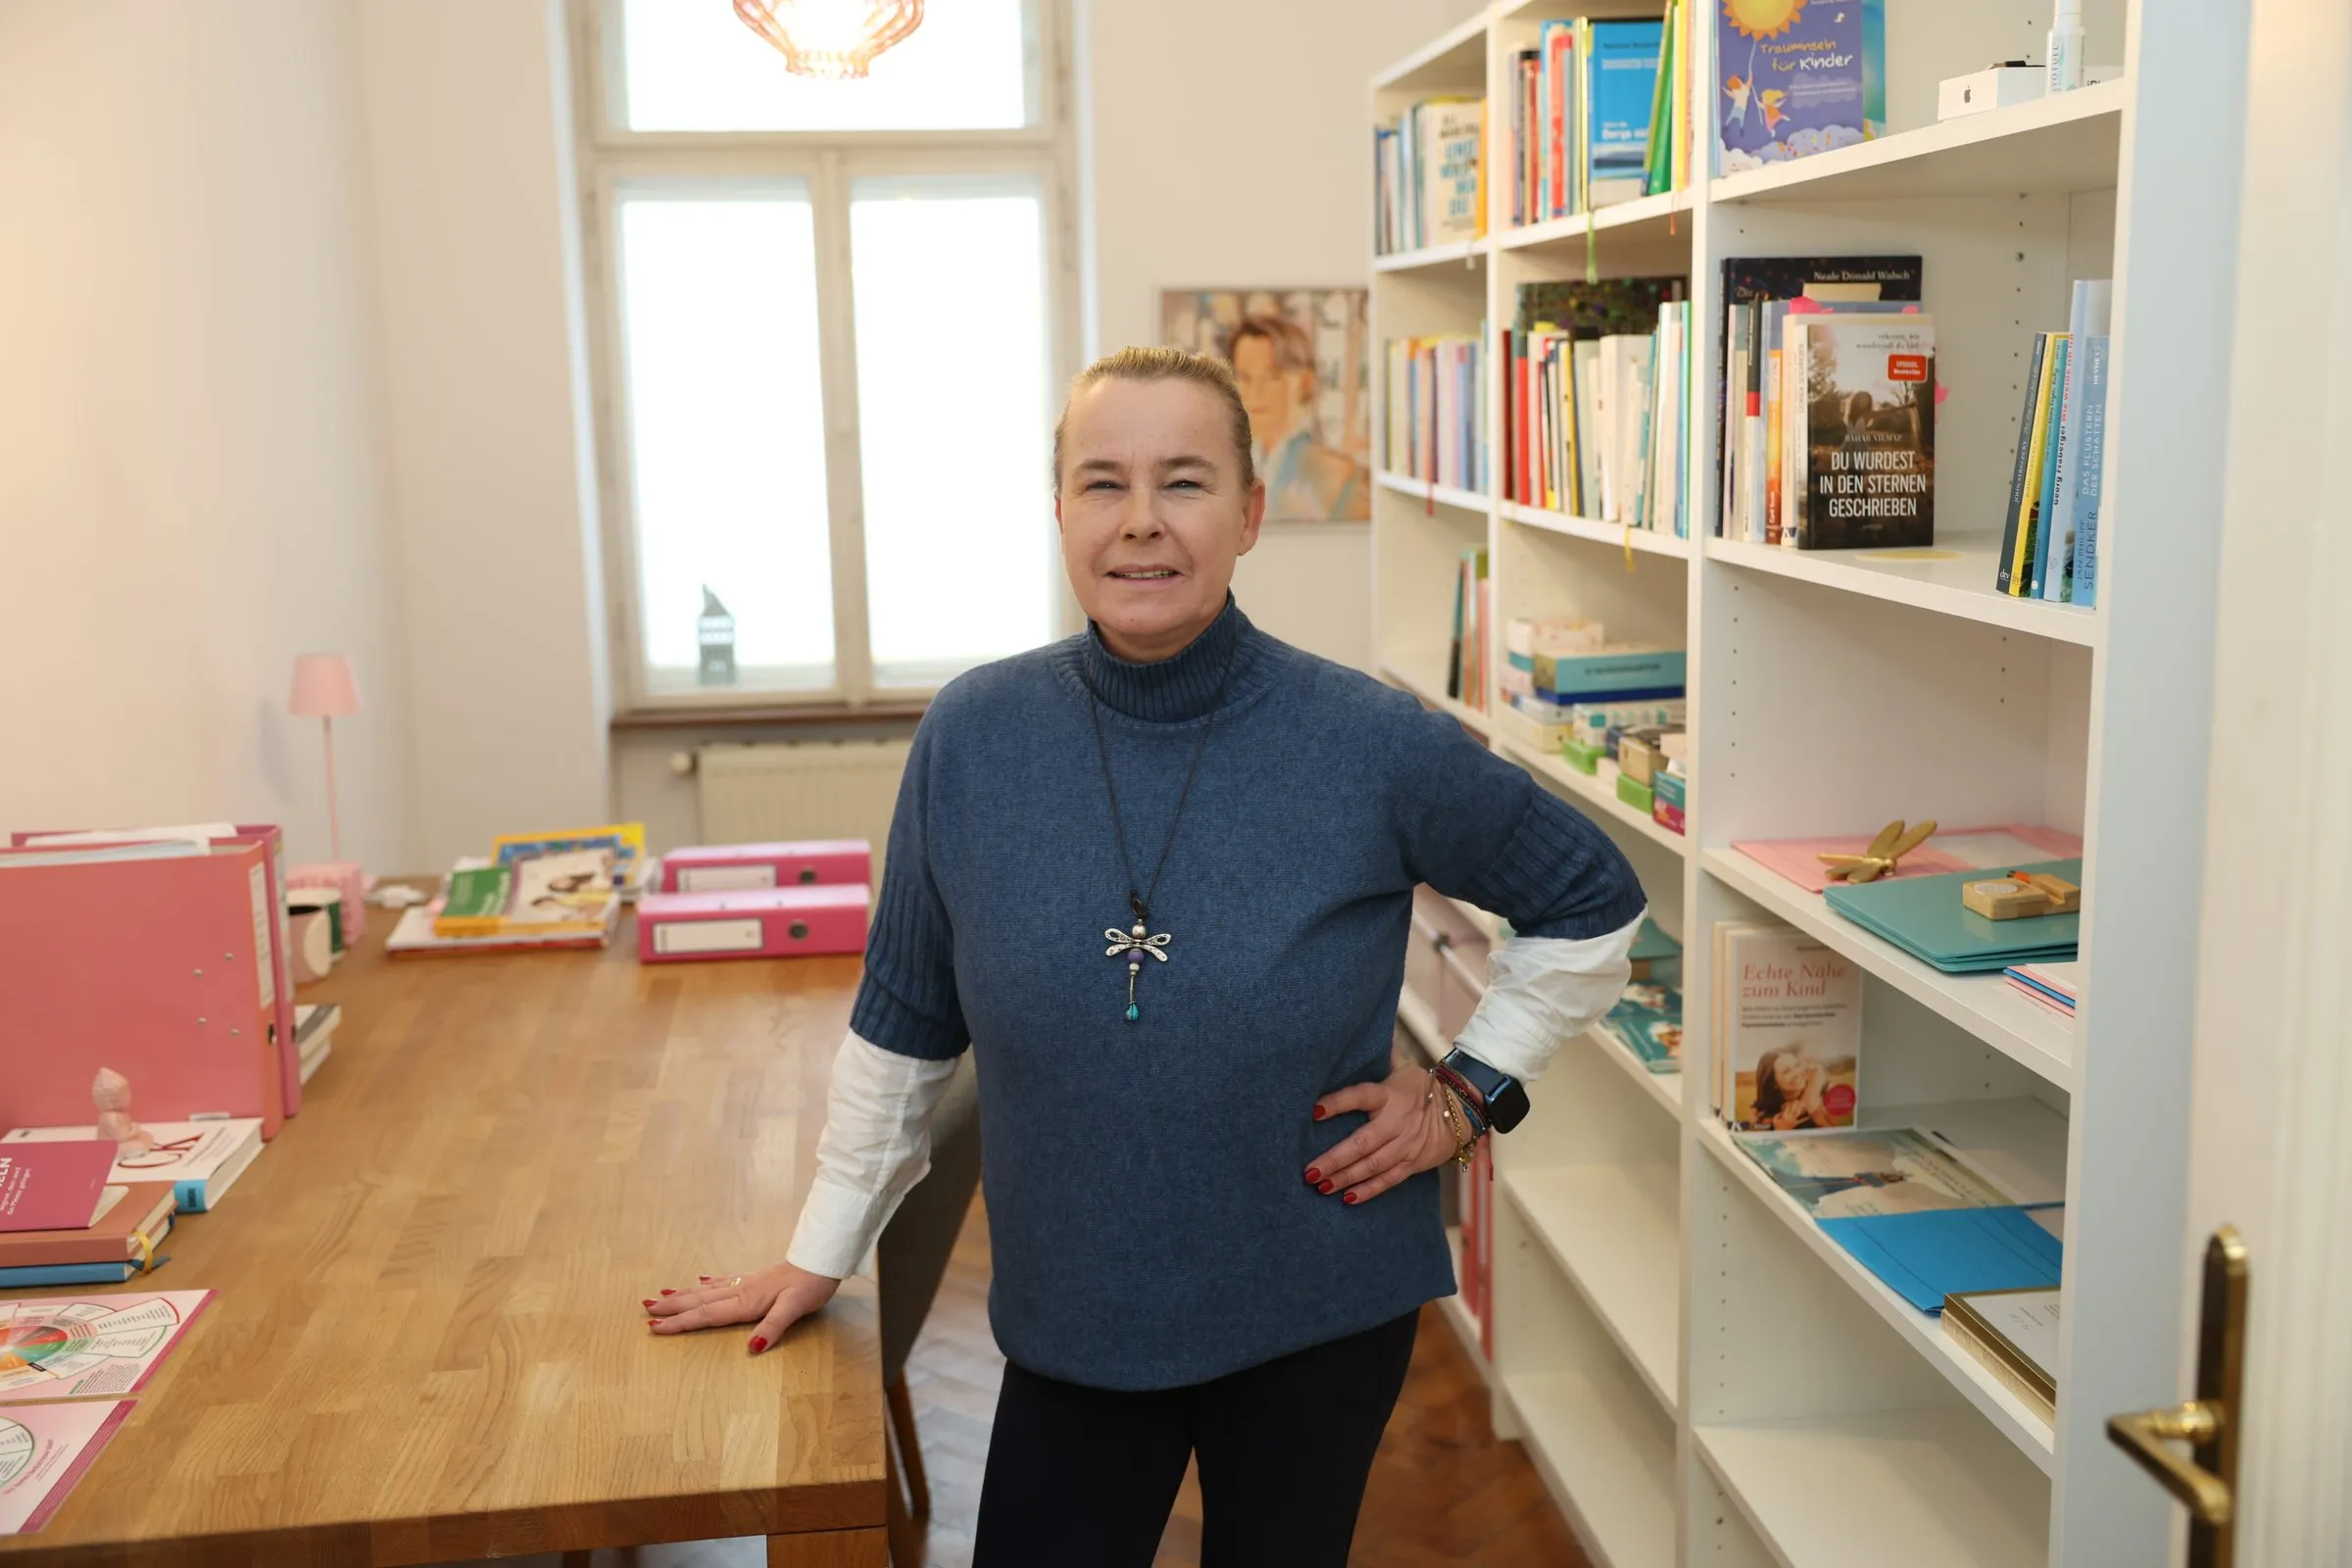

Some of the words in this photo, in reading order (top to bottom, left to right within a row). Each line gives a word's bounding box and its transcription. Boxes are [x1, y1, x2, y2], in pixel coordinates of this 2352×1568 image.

[1799, 52, 1853, 71] Kinder
[1813, 270, 1840, 280] Neale
[1842, 270, 1876, 280] Donald
[1831, 451, 1849, 470] DU
[1853, 451, 1916, 469] WURDEST
[1820, 475, 1833, 494] IN
[1838, 475, 1863, 494] DEN
[1868, 474, 1927, 494] STERNEN
[1829, 498, 1917, 517] GESCHRIEBEN
[2084, 511, 2097, 590] SENDKER
[1743, 963, 1793, 980] Echte
[1742, 985, 1779, 998] zum
[1786, 980, 1827, 997] Kind
